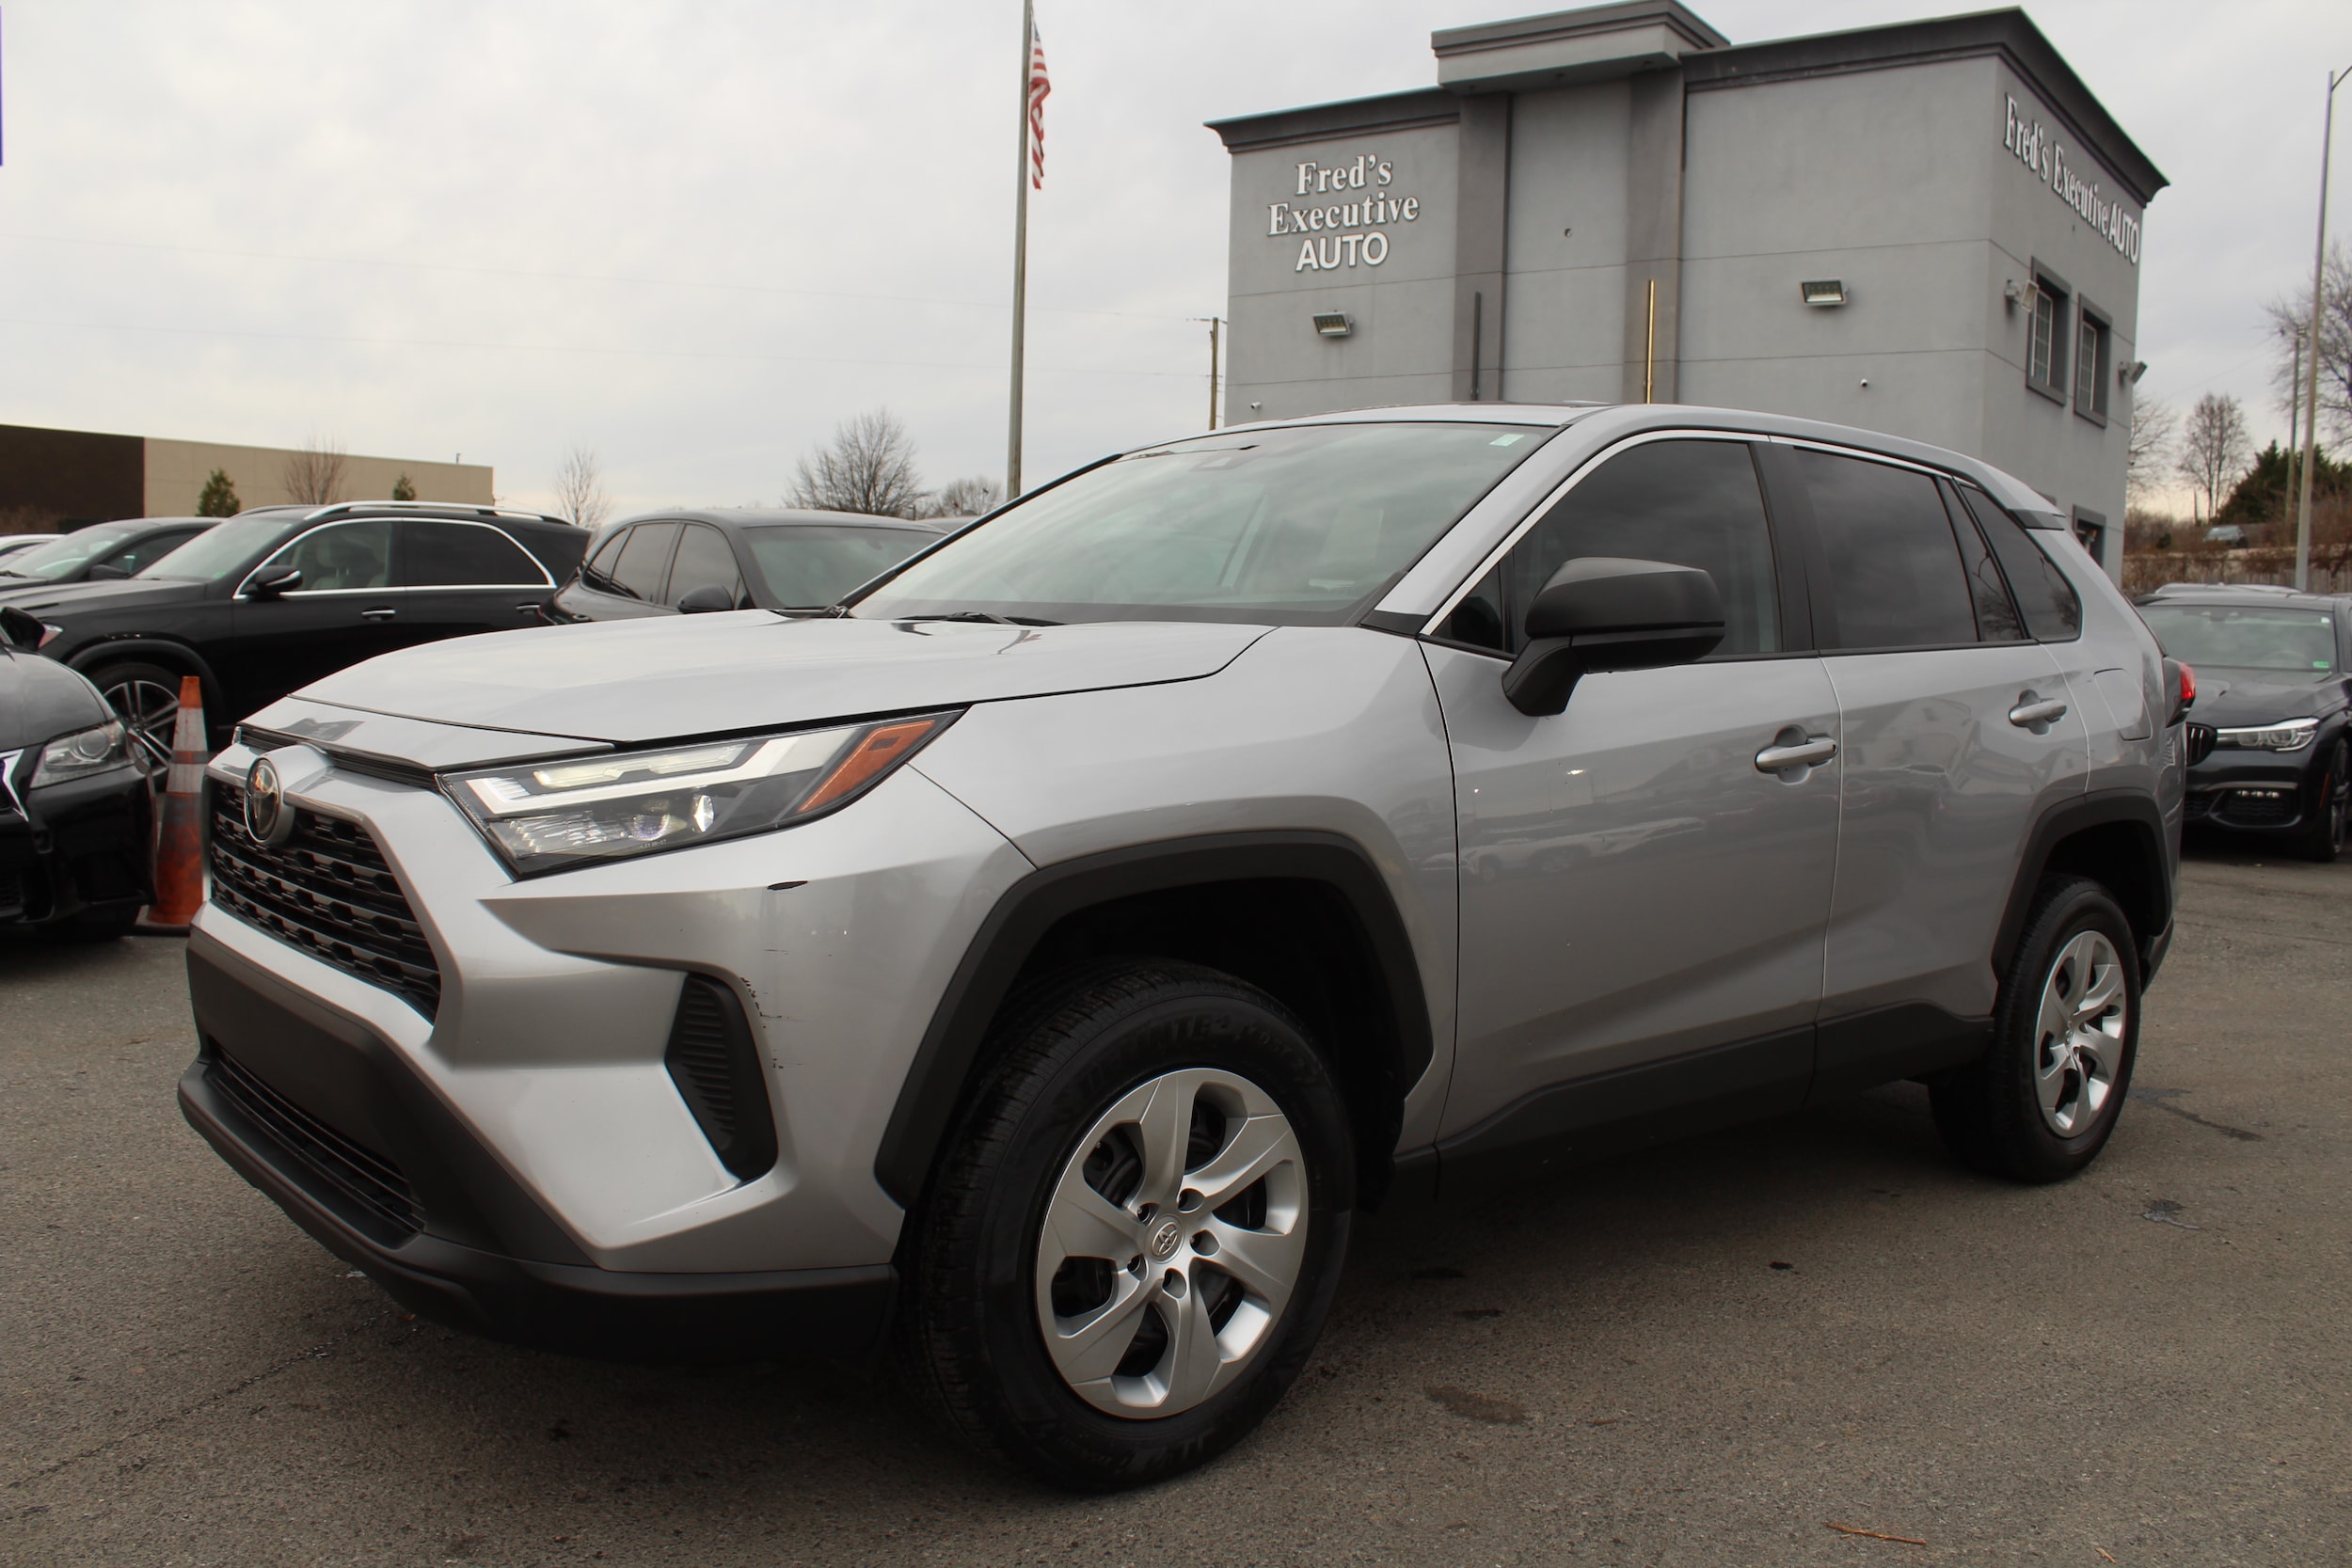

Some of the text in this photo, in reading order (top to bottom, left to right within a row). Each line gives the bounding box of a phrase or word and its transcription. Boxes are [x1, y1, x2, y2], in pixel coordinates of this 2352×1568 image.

[1295, 153, 1393, 196] Fred's
[2004, 92, 2139, 264] Fred's Executive AUTO
[1267, 191, 1420, 236] Executive
[1295, 230, 1390, 272] AUTO
